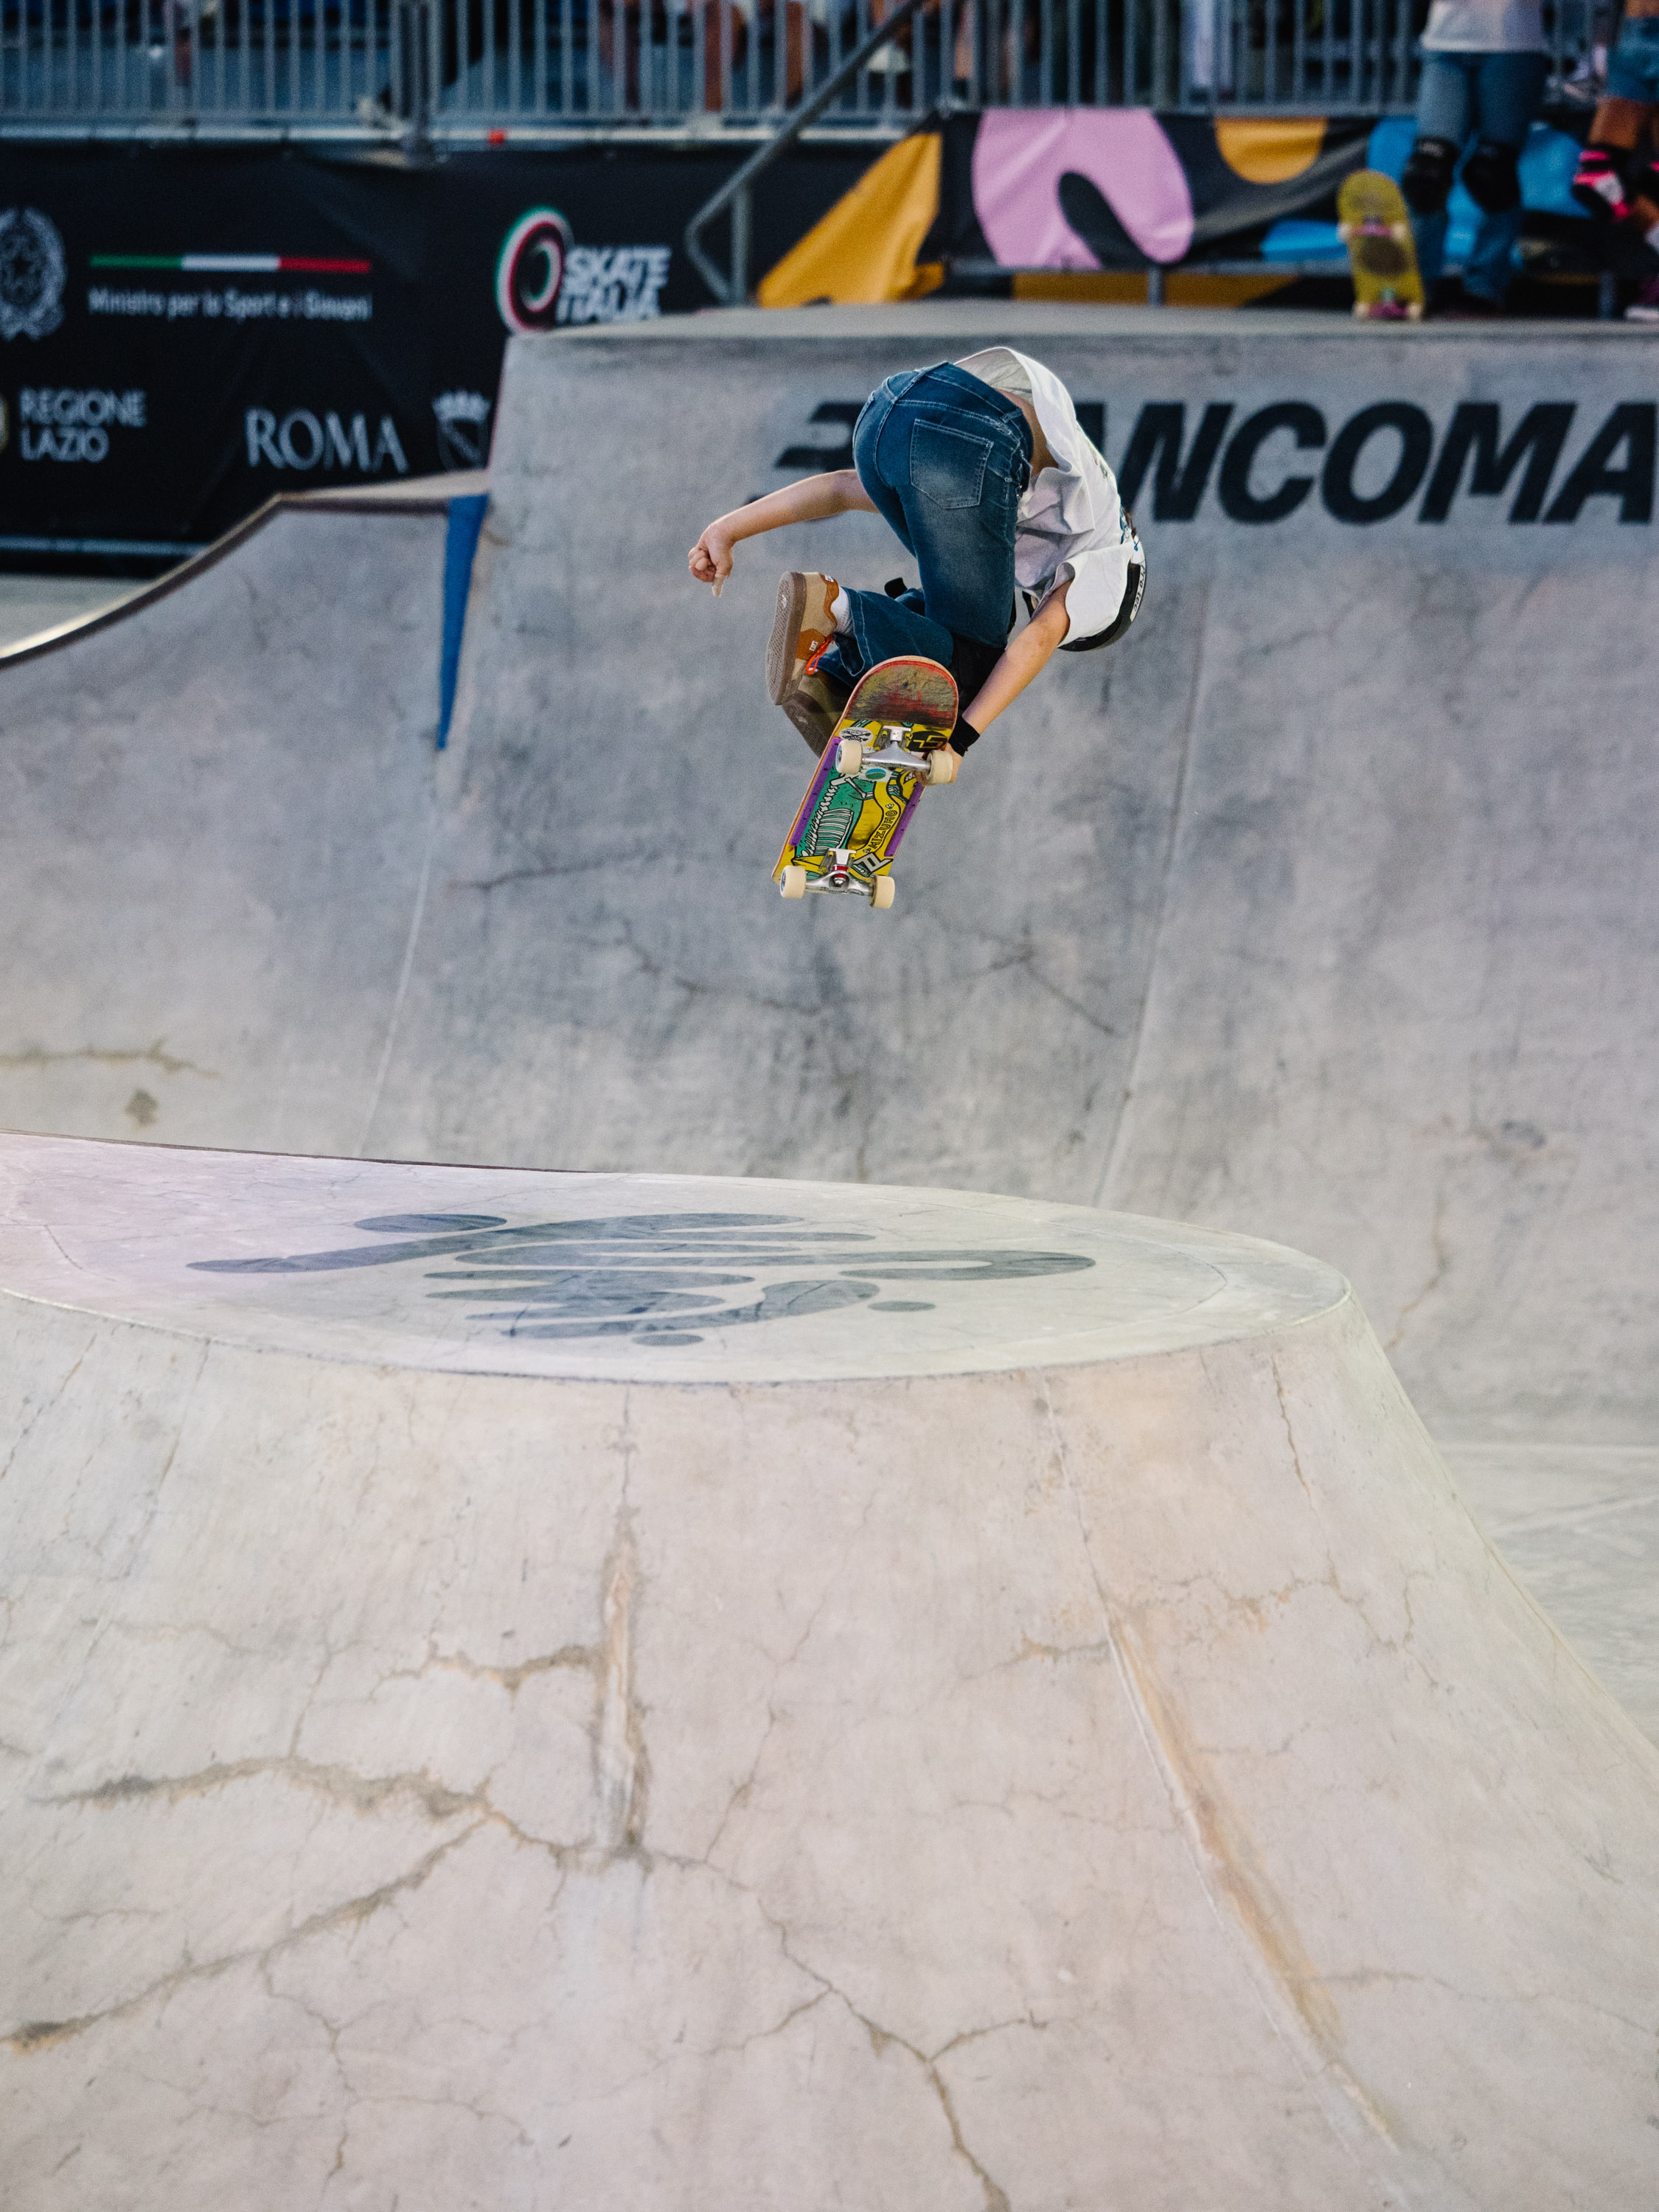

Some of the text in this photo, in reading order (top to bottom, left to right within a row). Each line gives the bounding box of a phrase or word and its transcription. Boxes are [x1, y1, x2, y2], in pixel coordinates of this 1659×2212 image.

[565, 244, 673, 296] SKATE
[19, 387, 146, 426] REGIONE
[20, 426, 109, 462] LAZIO
[245, 406, 408, 472] ROMA
[868, 810, 898, 849] MIZUHO
